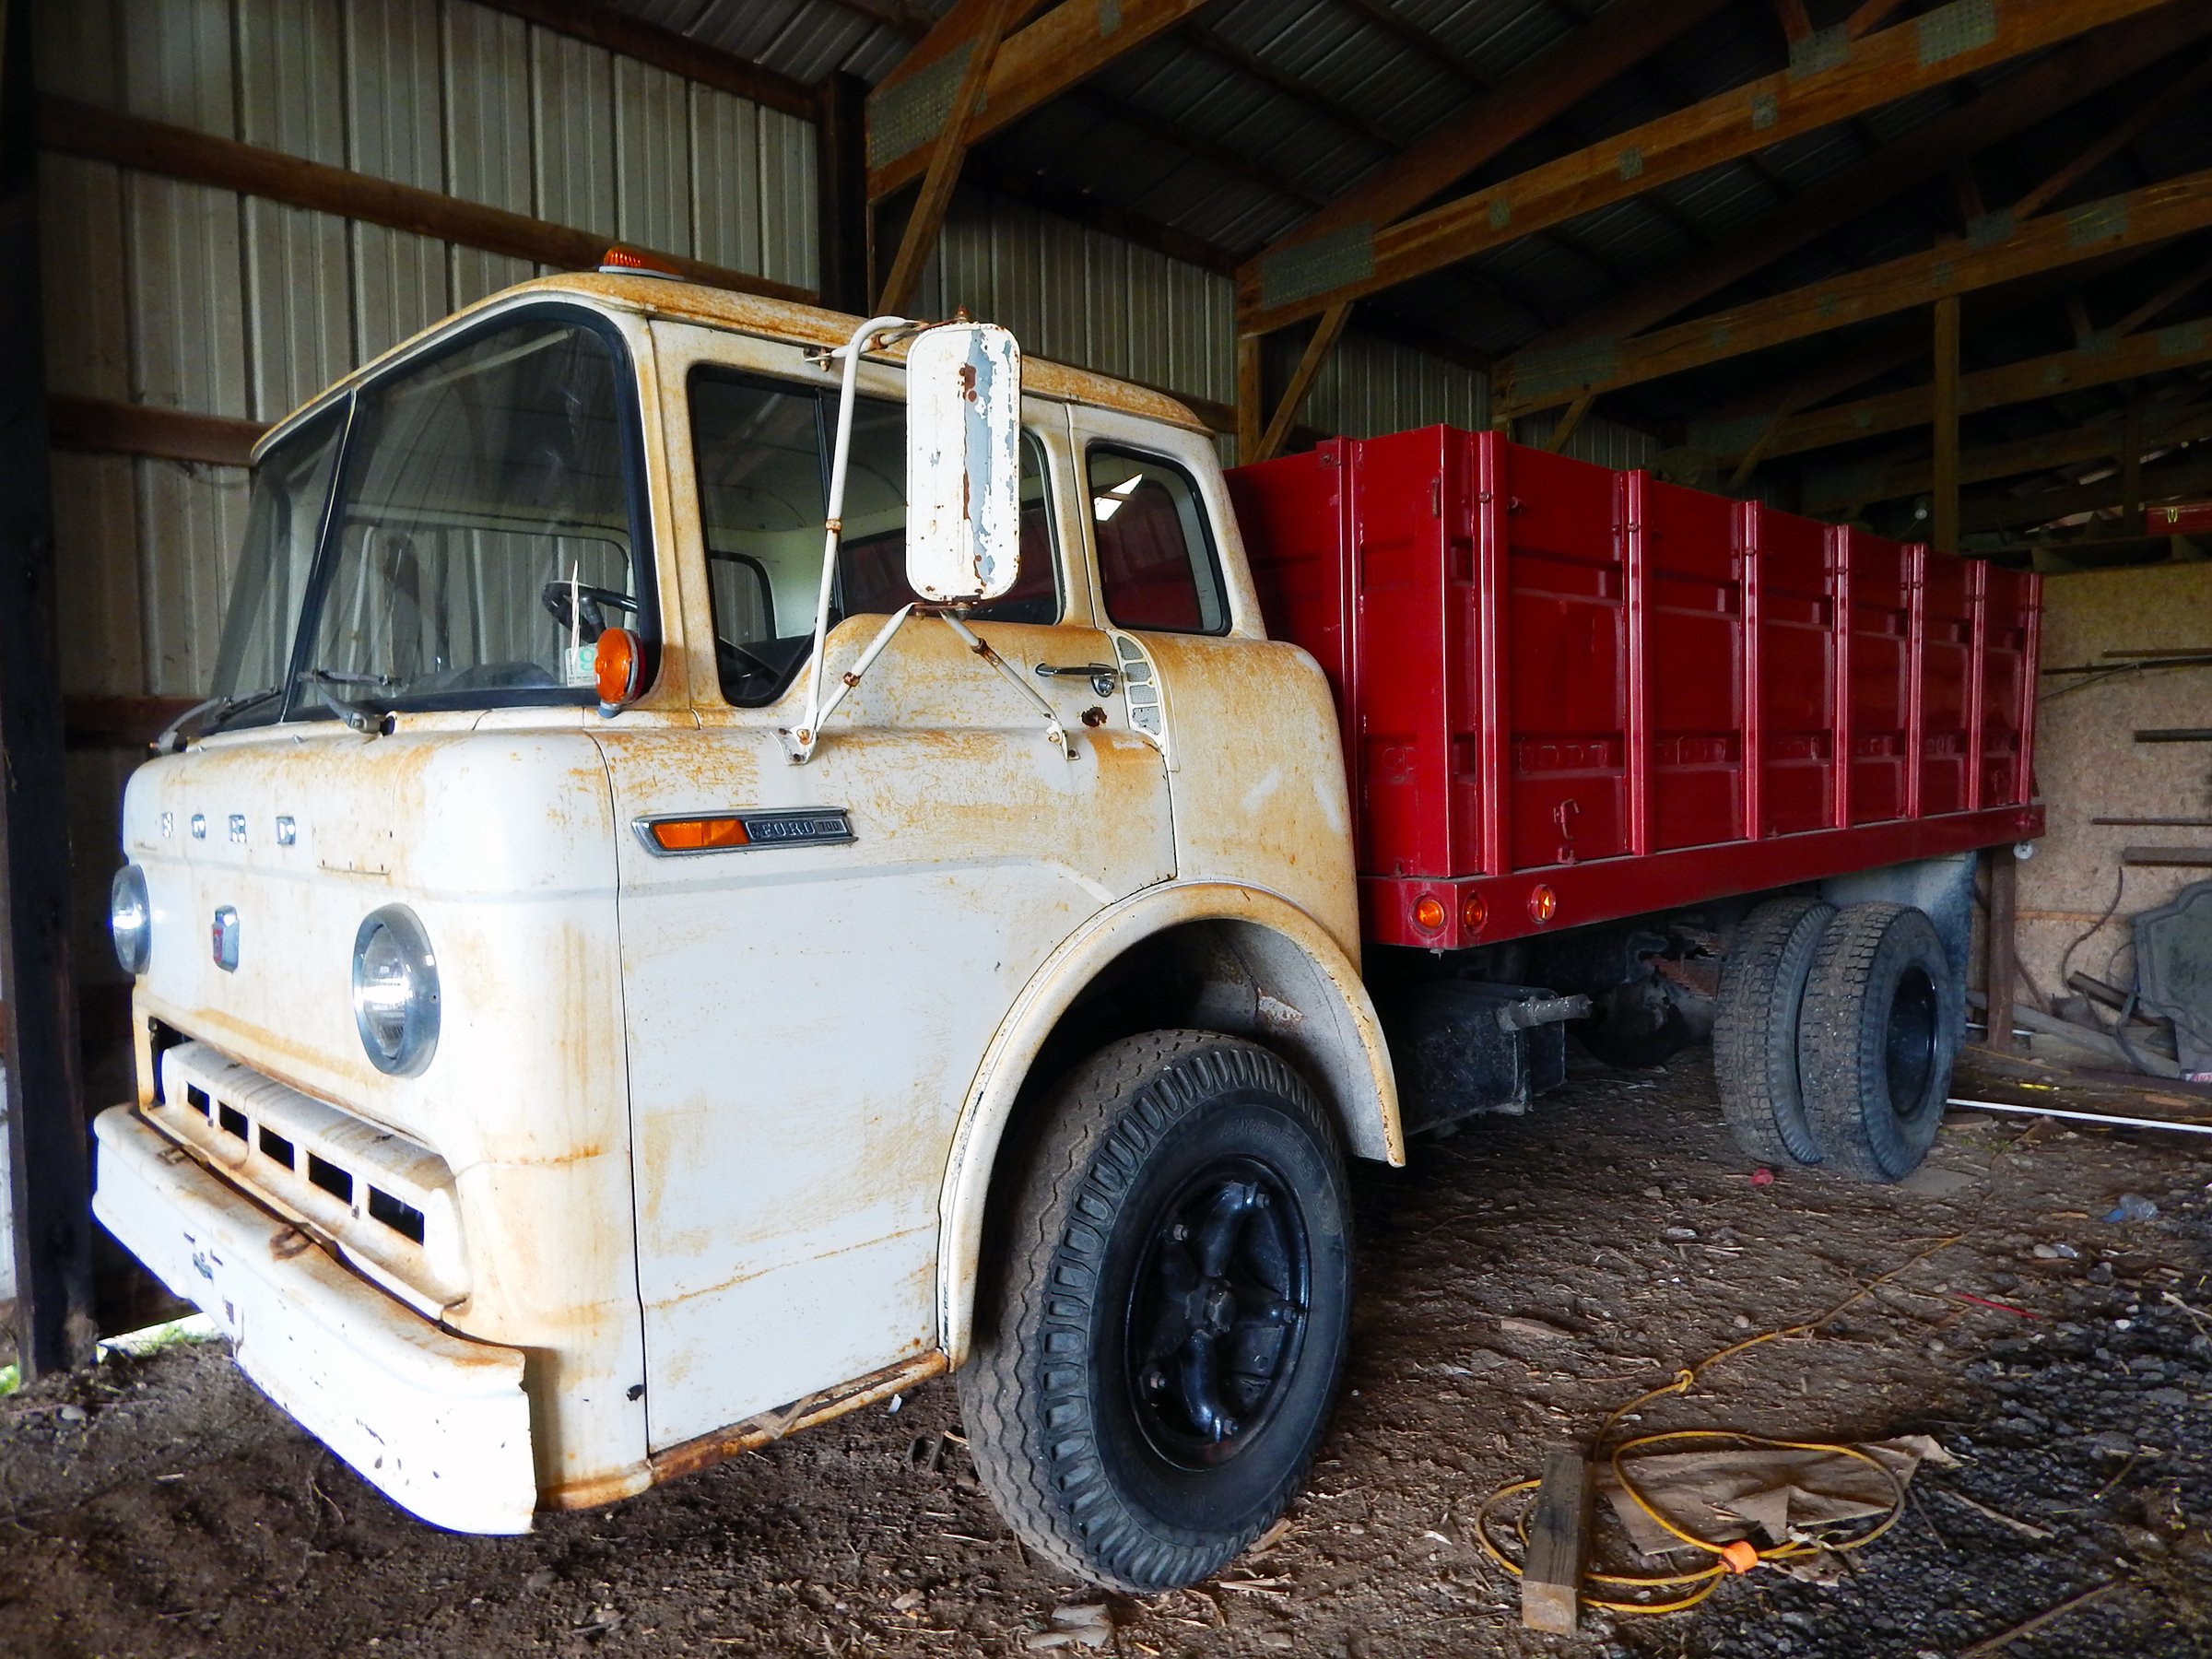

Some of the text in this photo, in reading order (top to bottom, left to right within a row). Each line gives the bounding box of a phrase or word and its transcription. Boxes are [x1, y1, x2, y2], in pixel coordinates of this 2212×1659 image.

[161, 812, 296, 846] FORD
[761, 819, 841, 839] FORD 700
[1220, 1118, 1317, 1182] EXPRESS
